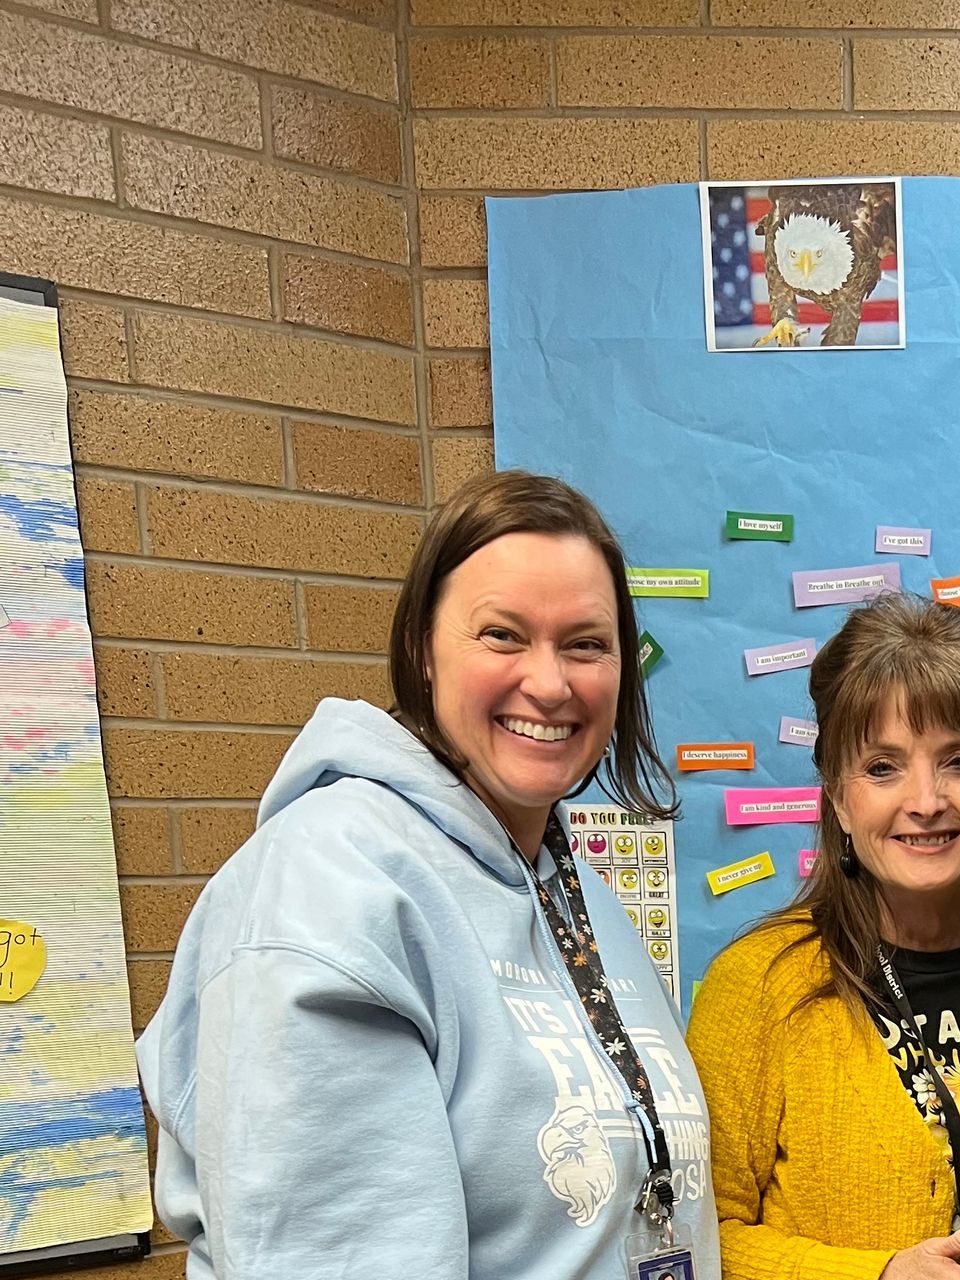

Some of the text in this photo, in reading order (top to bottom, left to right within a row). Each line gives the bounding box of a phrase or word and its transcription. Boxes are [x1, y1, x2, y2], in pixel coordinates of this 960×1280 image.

[883, 536, 897, 544] I've
[674, 578, 700, 586] attitude
[808, 583, 835, 591] Breathe
[835, 581, 844, 589] in
[844, 579, 871, 588] Breathe
[771, 650, 806, 662] important
[713, 750, 747, 760] happiness
[755, 803, 771, 811] kind
[772, 802, 785, 810] and
[785, 801, 816, 810] generous
[569, 811, 587, 825] DO
[590, 812, 616, 825] YOU
[721, 872, 739, 882] never
[739, 867, 753, 877] give
[753, 863, 763, 872] up
[490, 959, 547, 985] MORONI
[883, 964, 903, 1000] District
[503, 996, 568, 1034] IT'S
